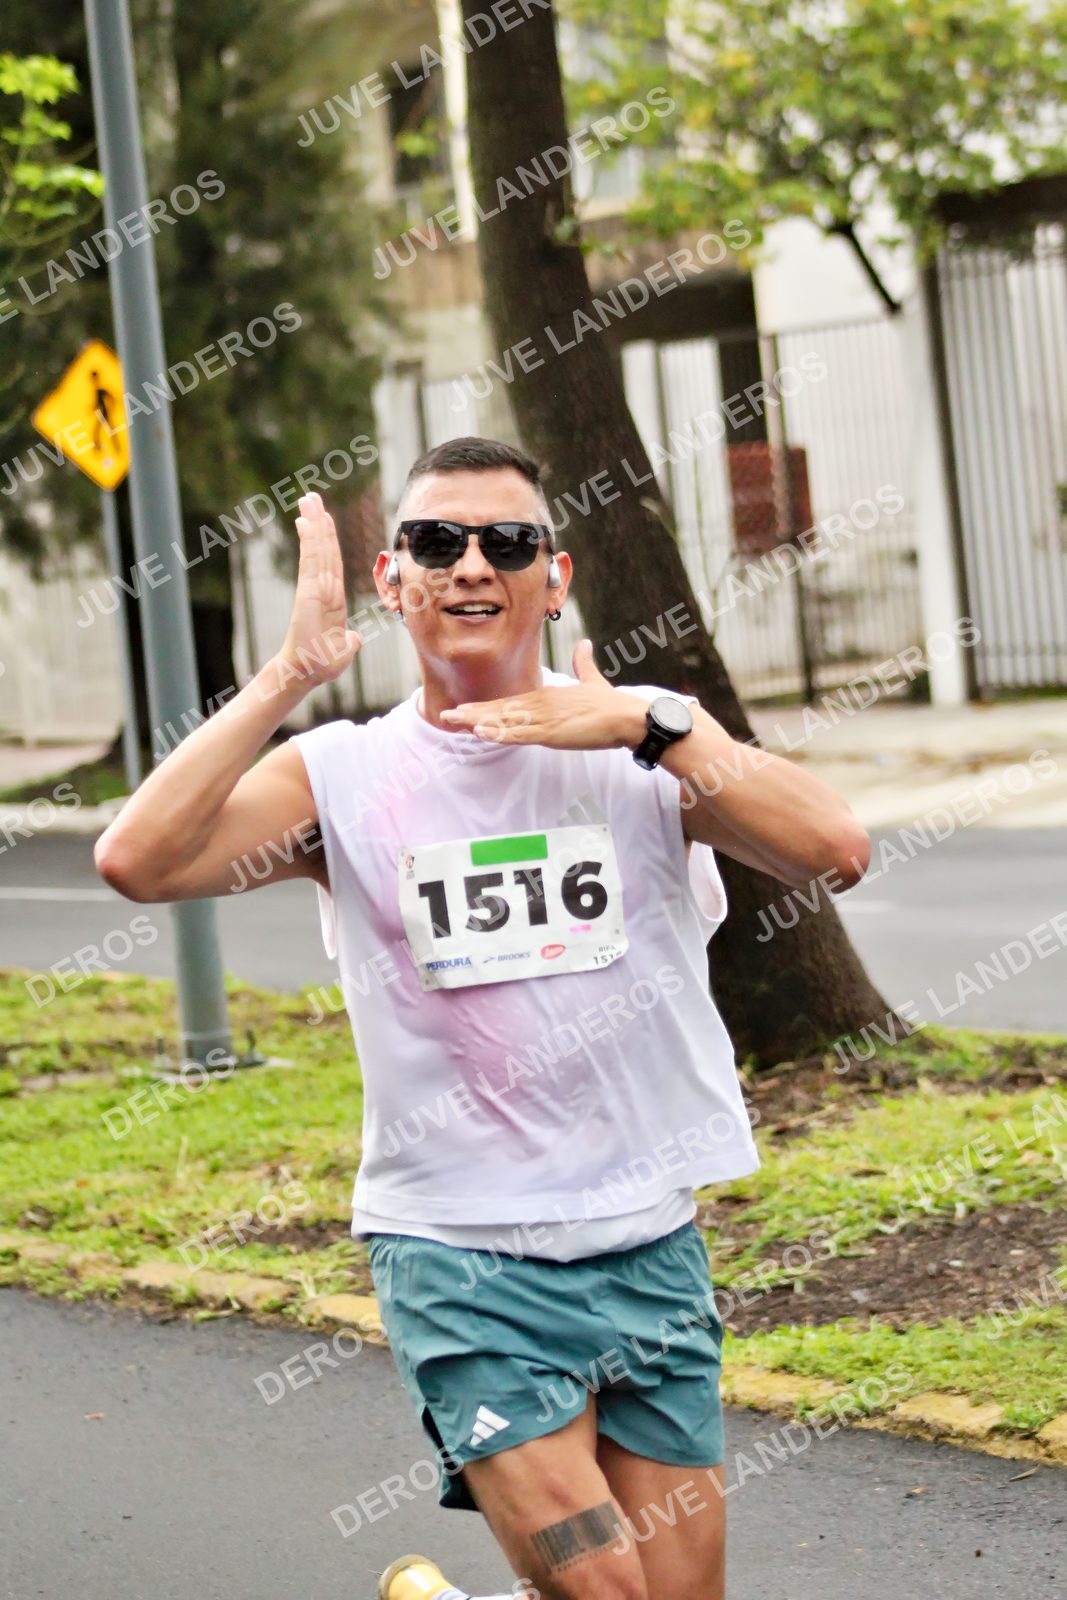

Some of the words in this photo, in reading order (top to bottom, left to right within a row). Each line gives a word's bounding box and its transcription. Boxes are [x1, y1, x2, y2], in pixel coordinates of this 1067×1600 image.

[418, 861, 608, 938] 1516
[497, 951, 530, 962] BROOKS
[426, 957, 472, 971] PERDURA
